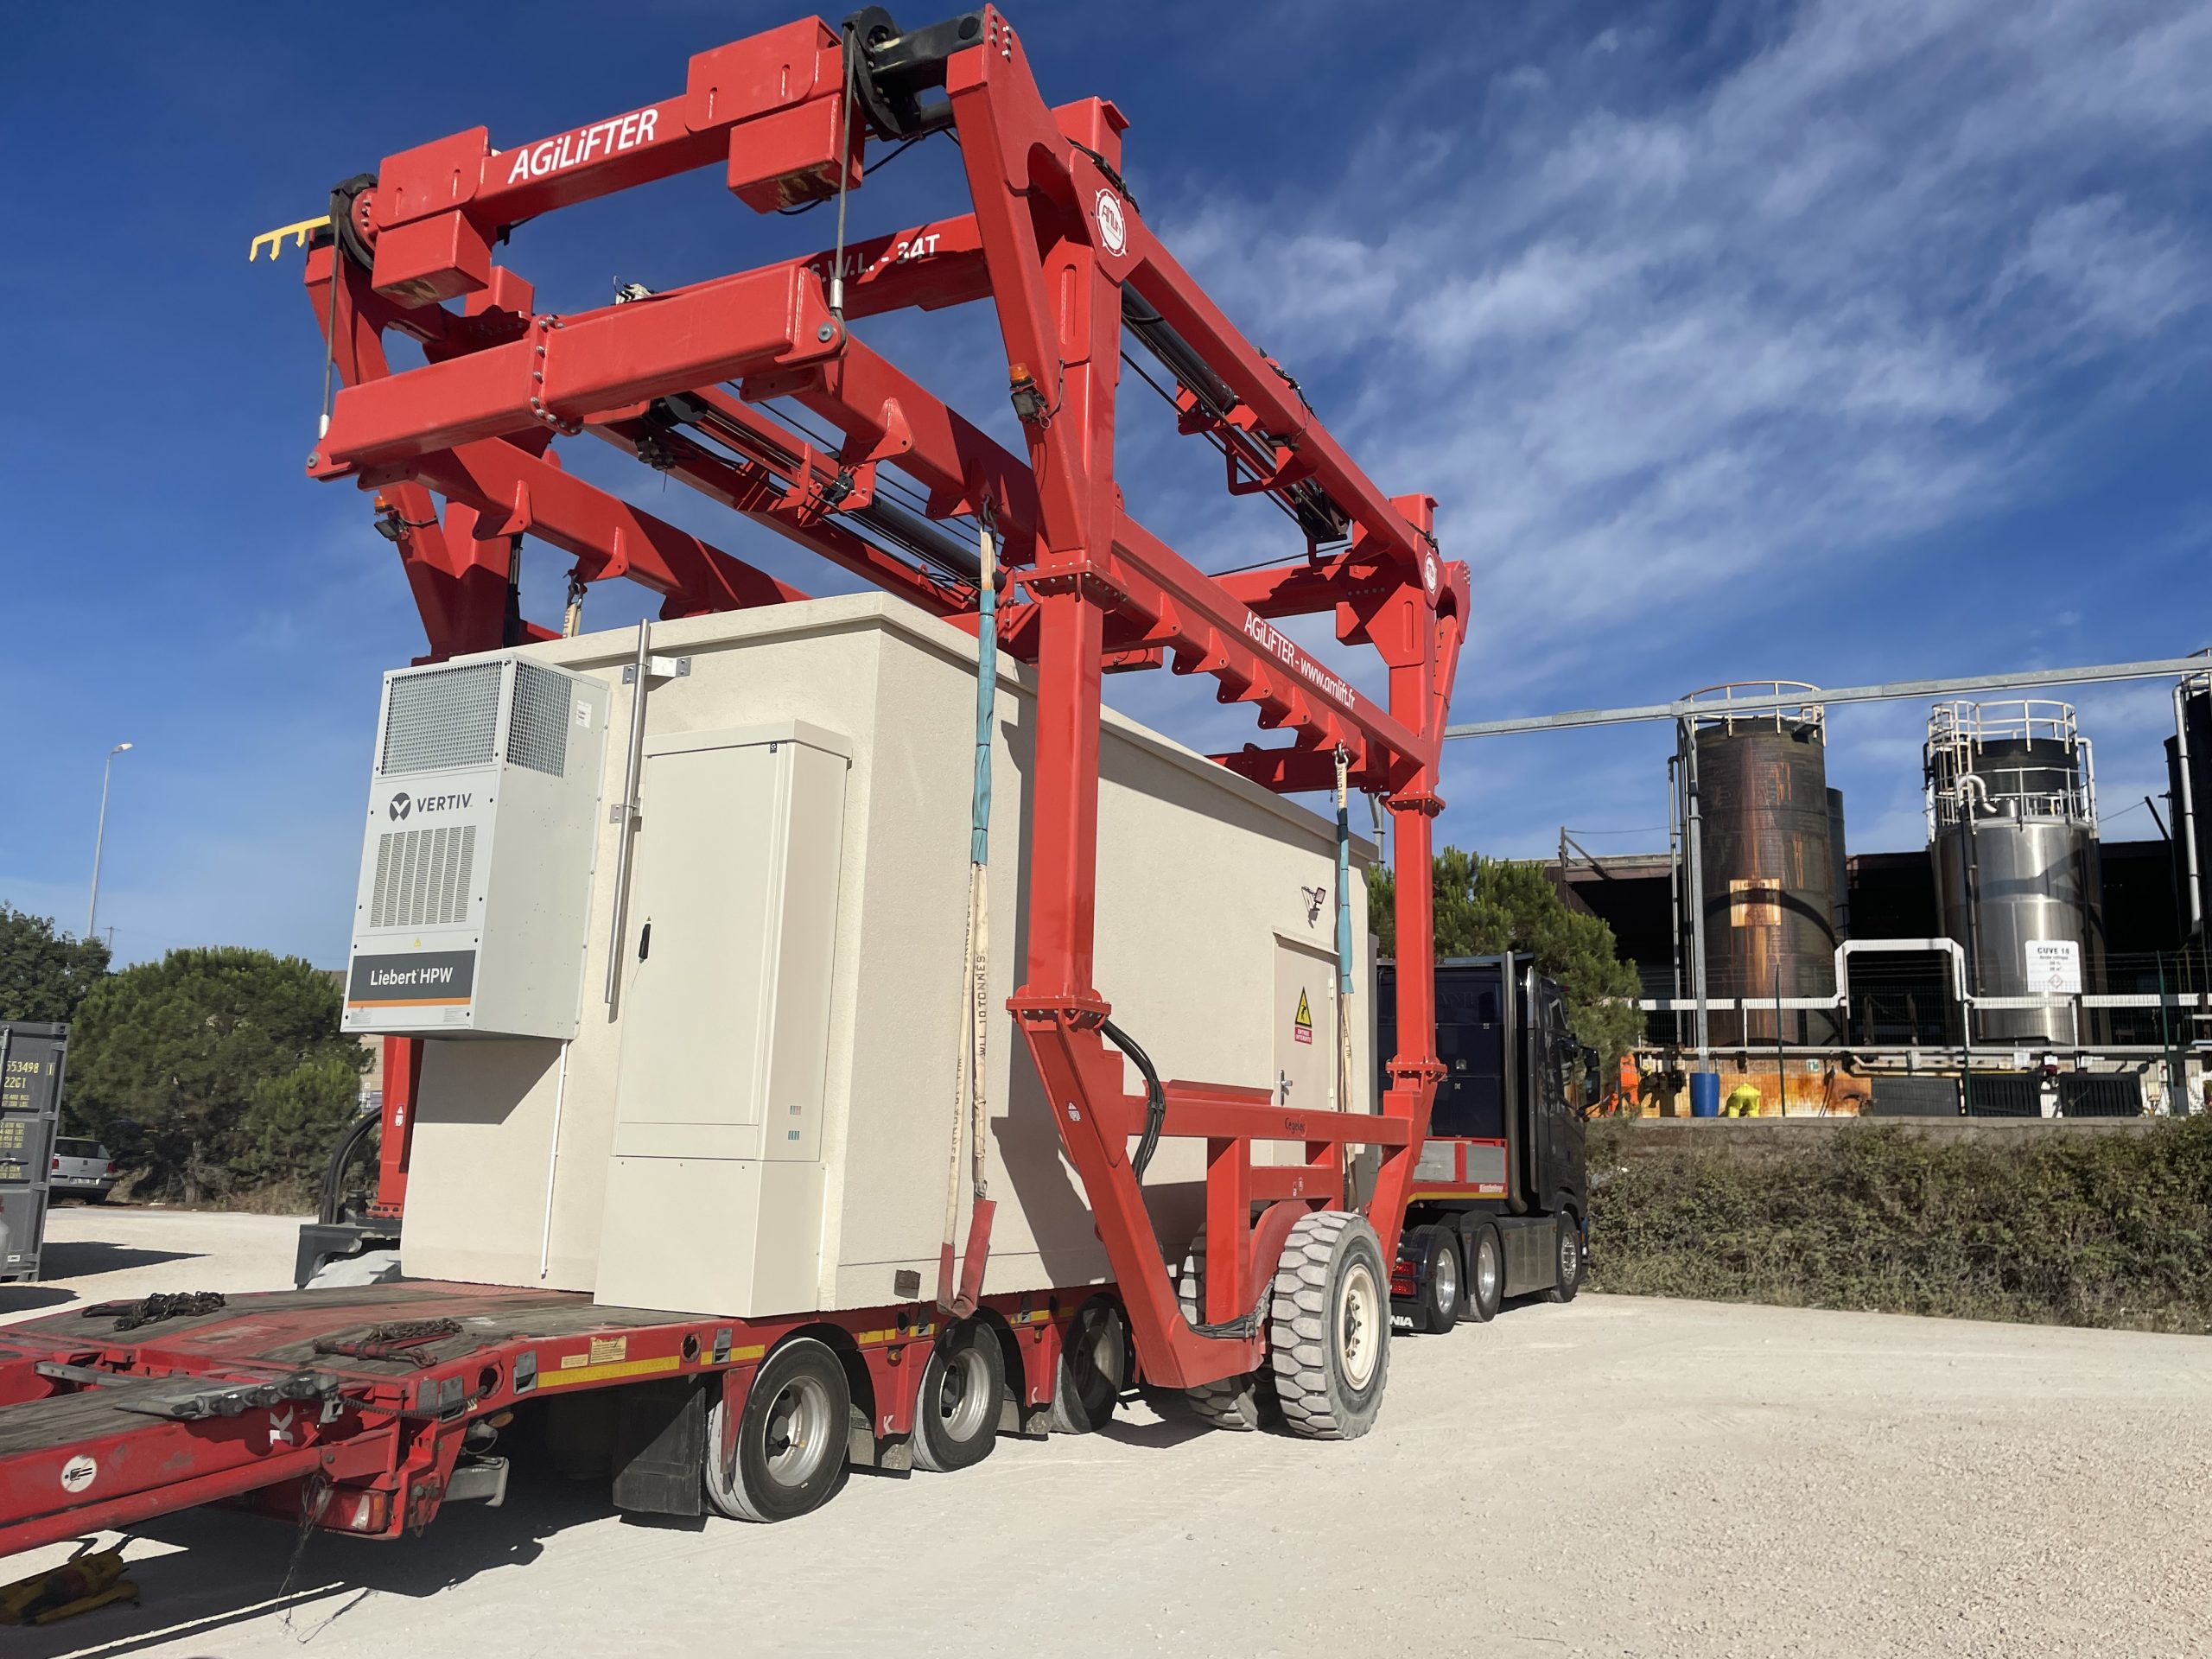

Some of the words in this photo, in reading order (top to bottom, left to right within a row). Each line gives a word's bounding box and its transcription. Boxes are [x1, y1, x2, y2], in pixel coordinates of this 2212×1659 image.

[897, 233, 940, 265] 34T
[1300, 658, 1356, 709] www.amlift.fr
[417, 793, 472, 813] VERTIV
[419, 967, 454, 984] HPW
[3, 1077, 27, 1089] 22G1
